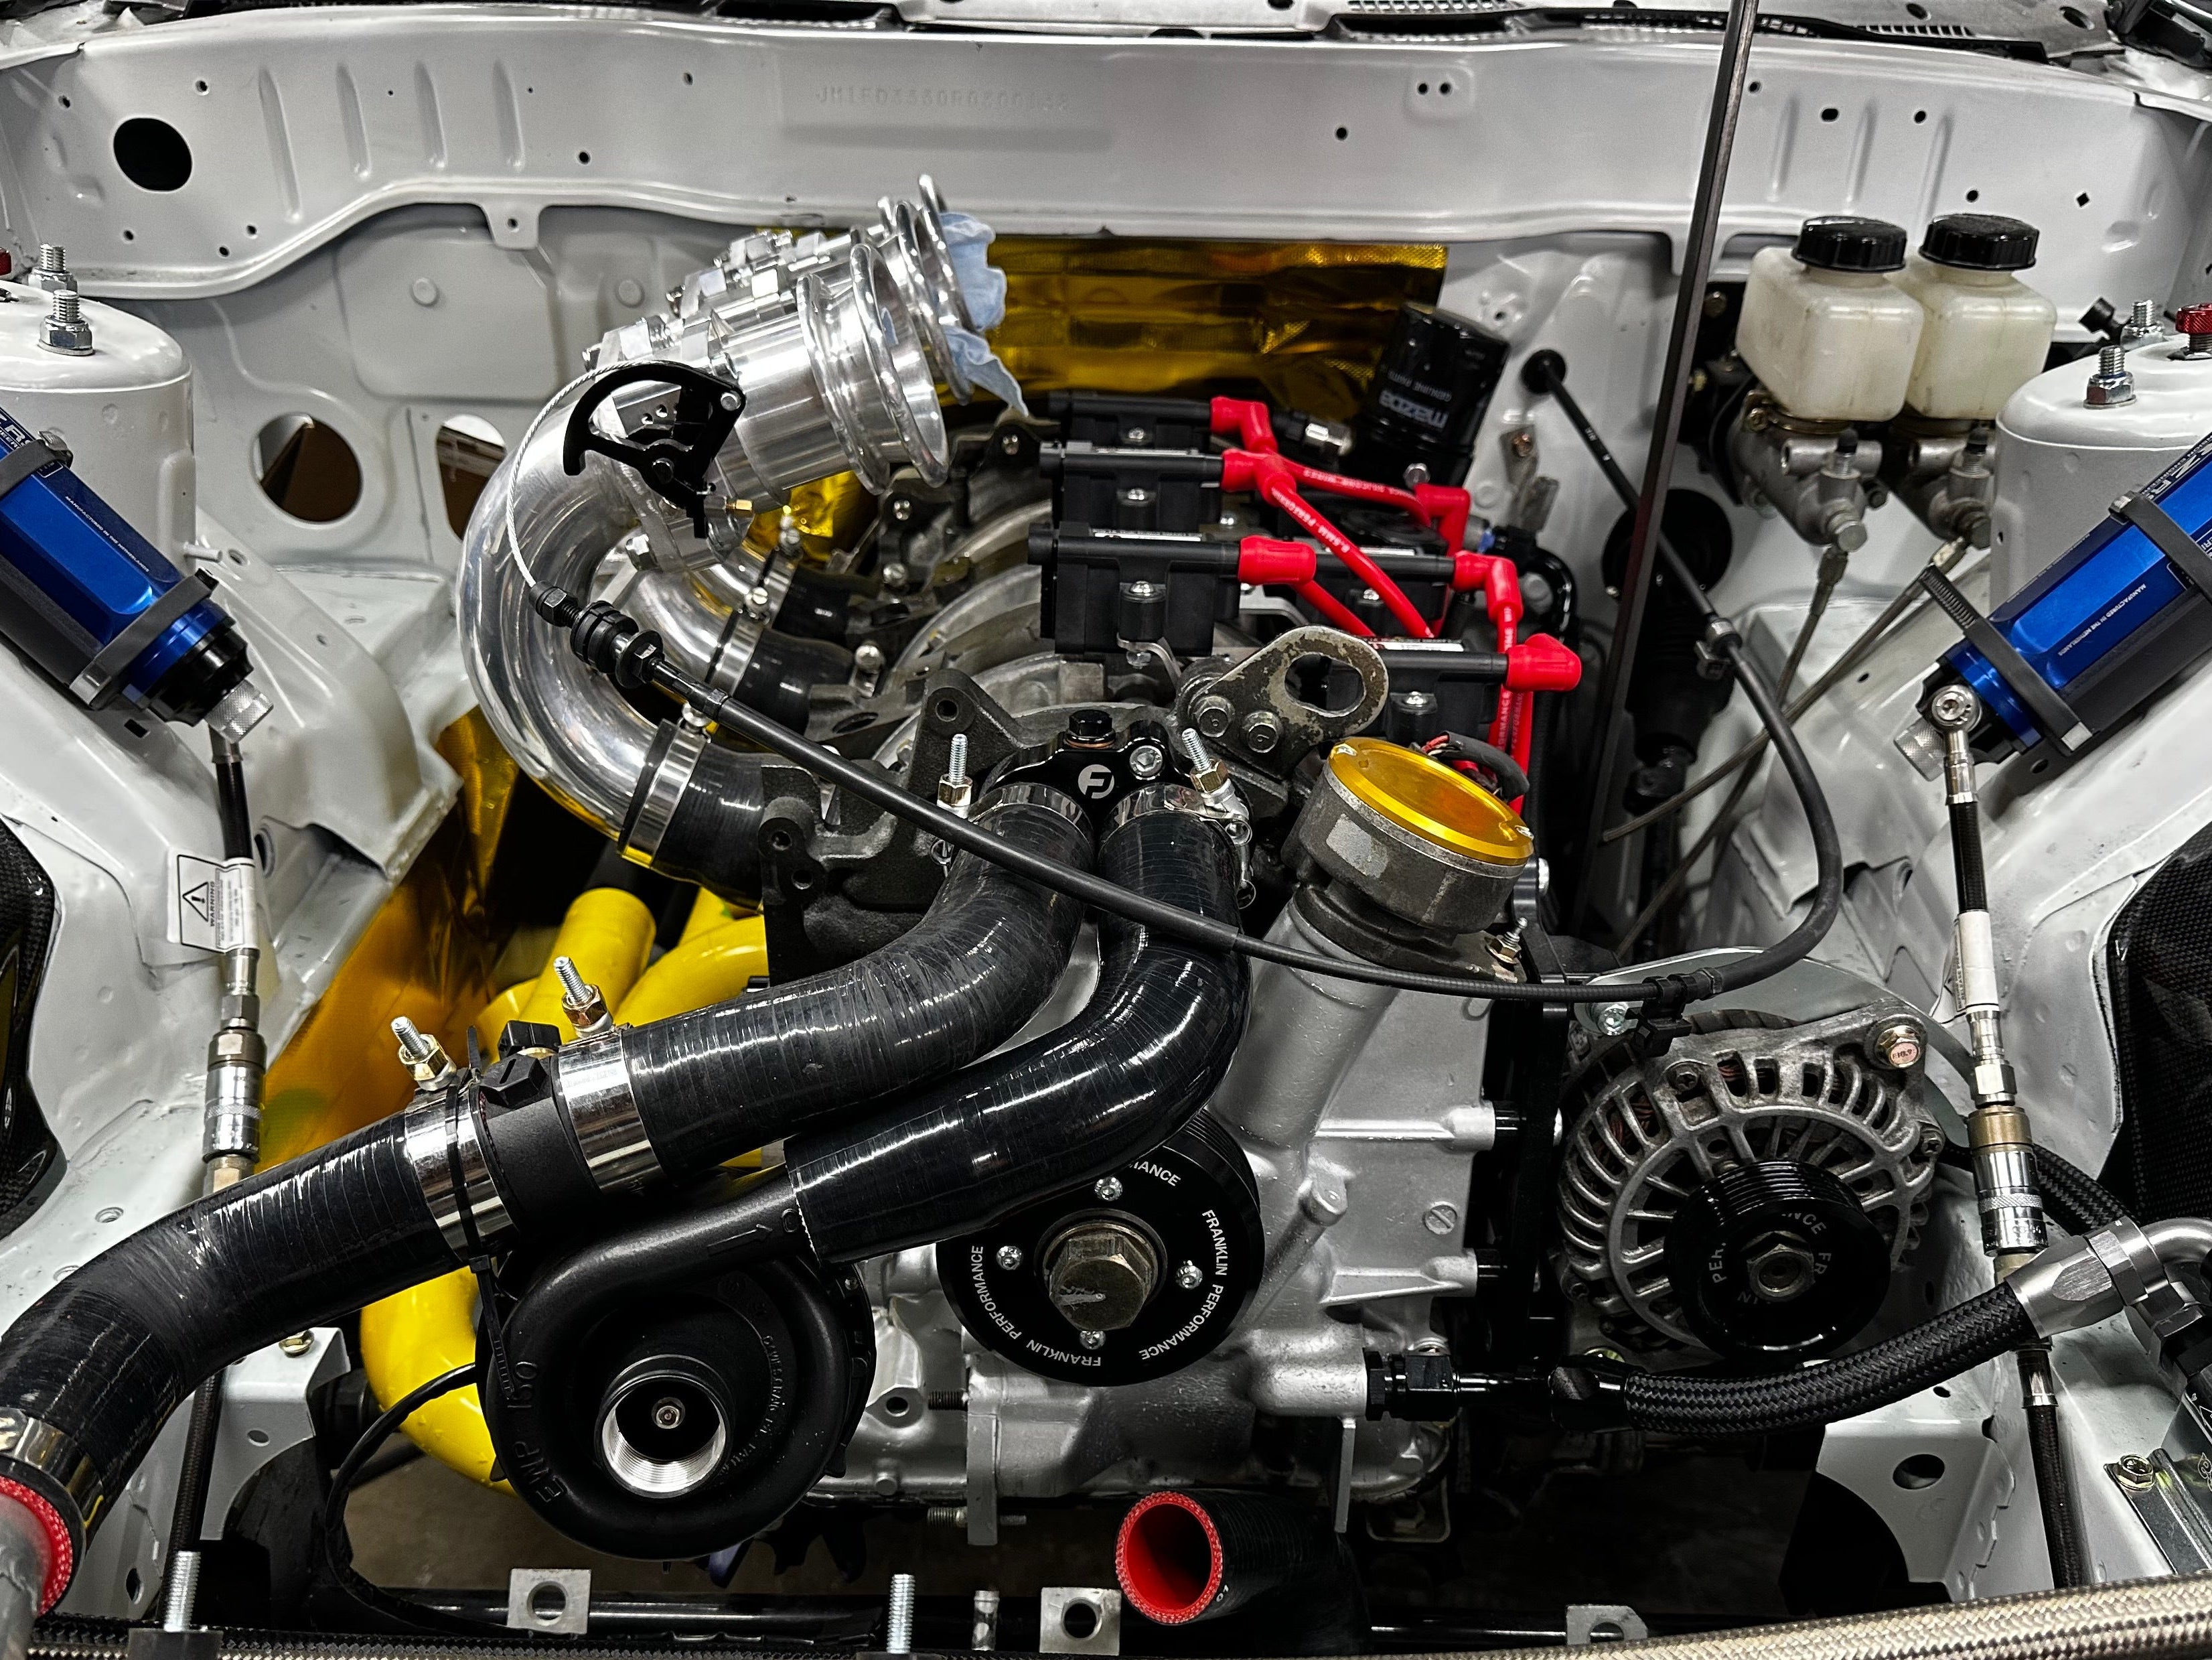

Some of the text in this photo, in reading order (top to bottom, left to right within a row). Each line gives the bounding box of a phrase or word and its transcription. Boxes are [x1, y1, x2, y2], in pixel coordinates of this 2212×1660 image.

[1378, 389, 1449, 429] mazda
[65, 496, 104, 531] MANUFACTURED
[2106, 583, 2147, 618] MANUFACTURED
[2057, 628, 2092, 656] NETHERLANDS
[1132, 1161, 1181, 1186] ANCE
[1138, 1209, 1228, 1360] FRANKLIN PERFORMANCE
[971, 1245, 1102, 1367] FRANKLIN PERFORMANCE
[513, 1440, 568, 1503] EWP
